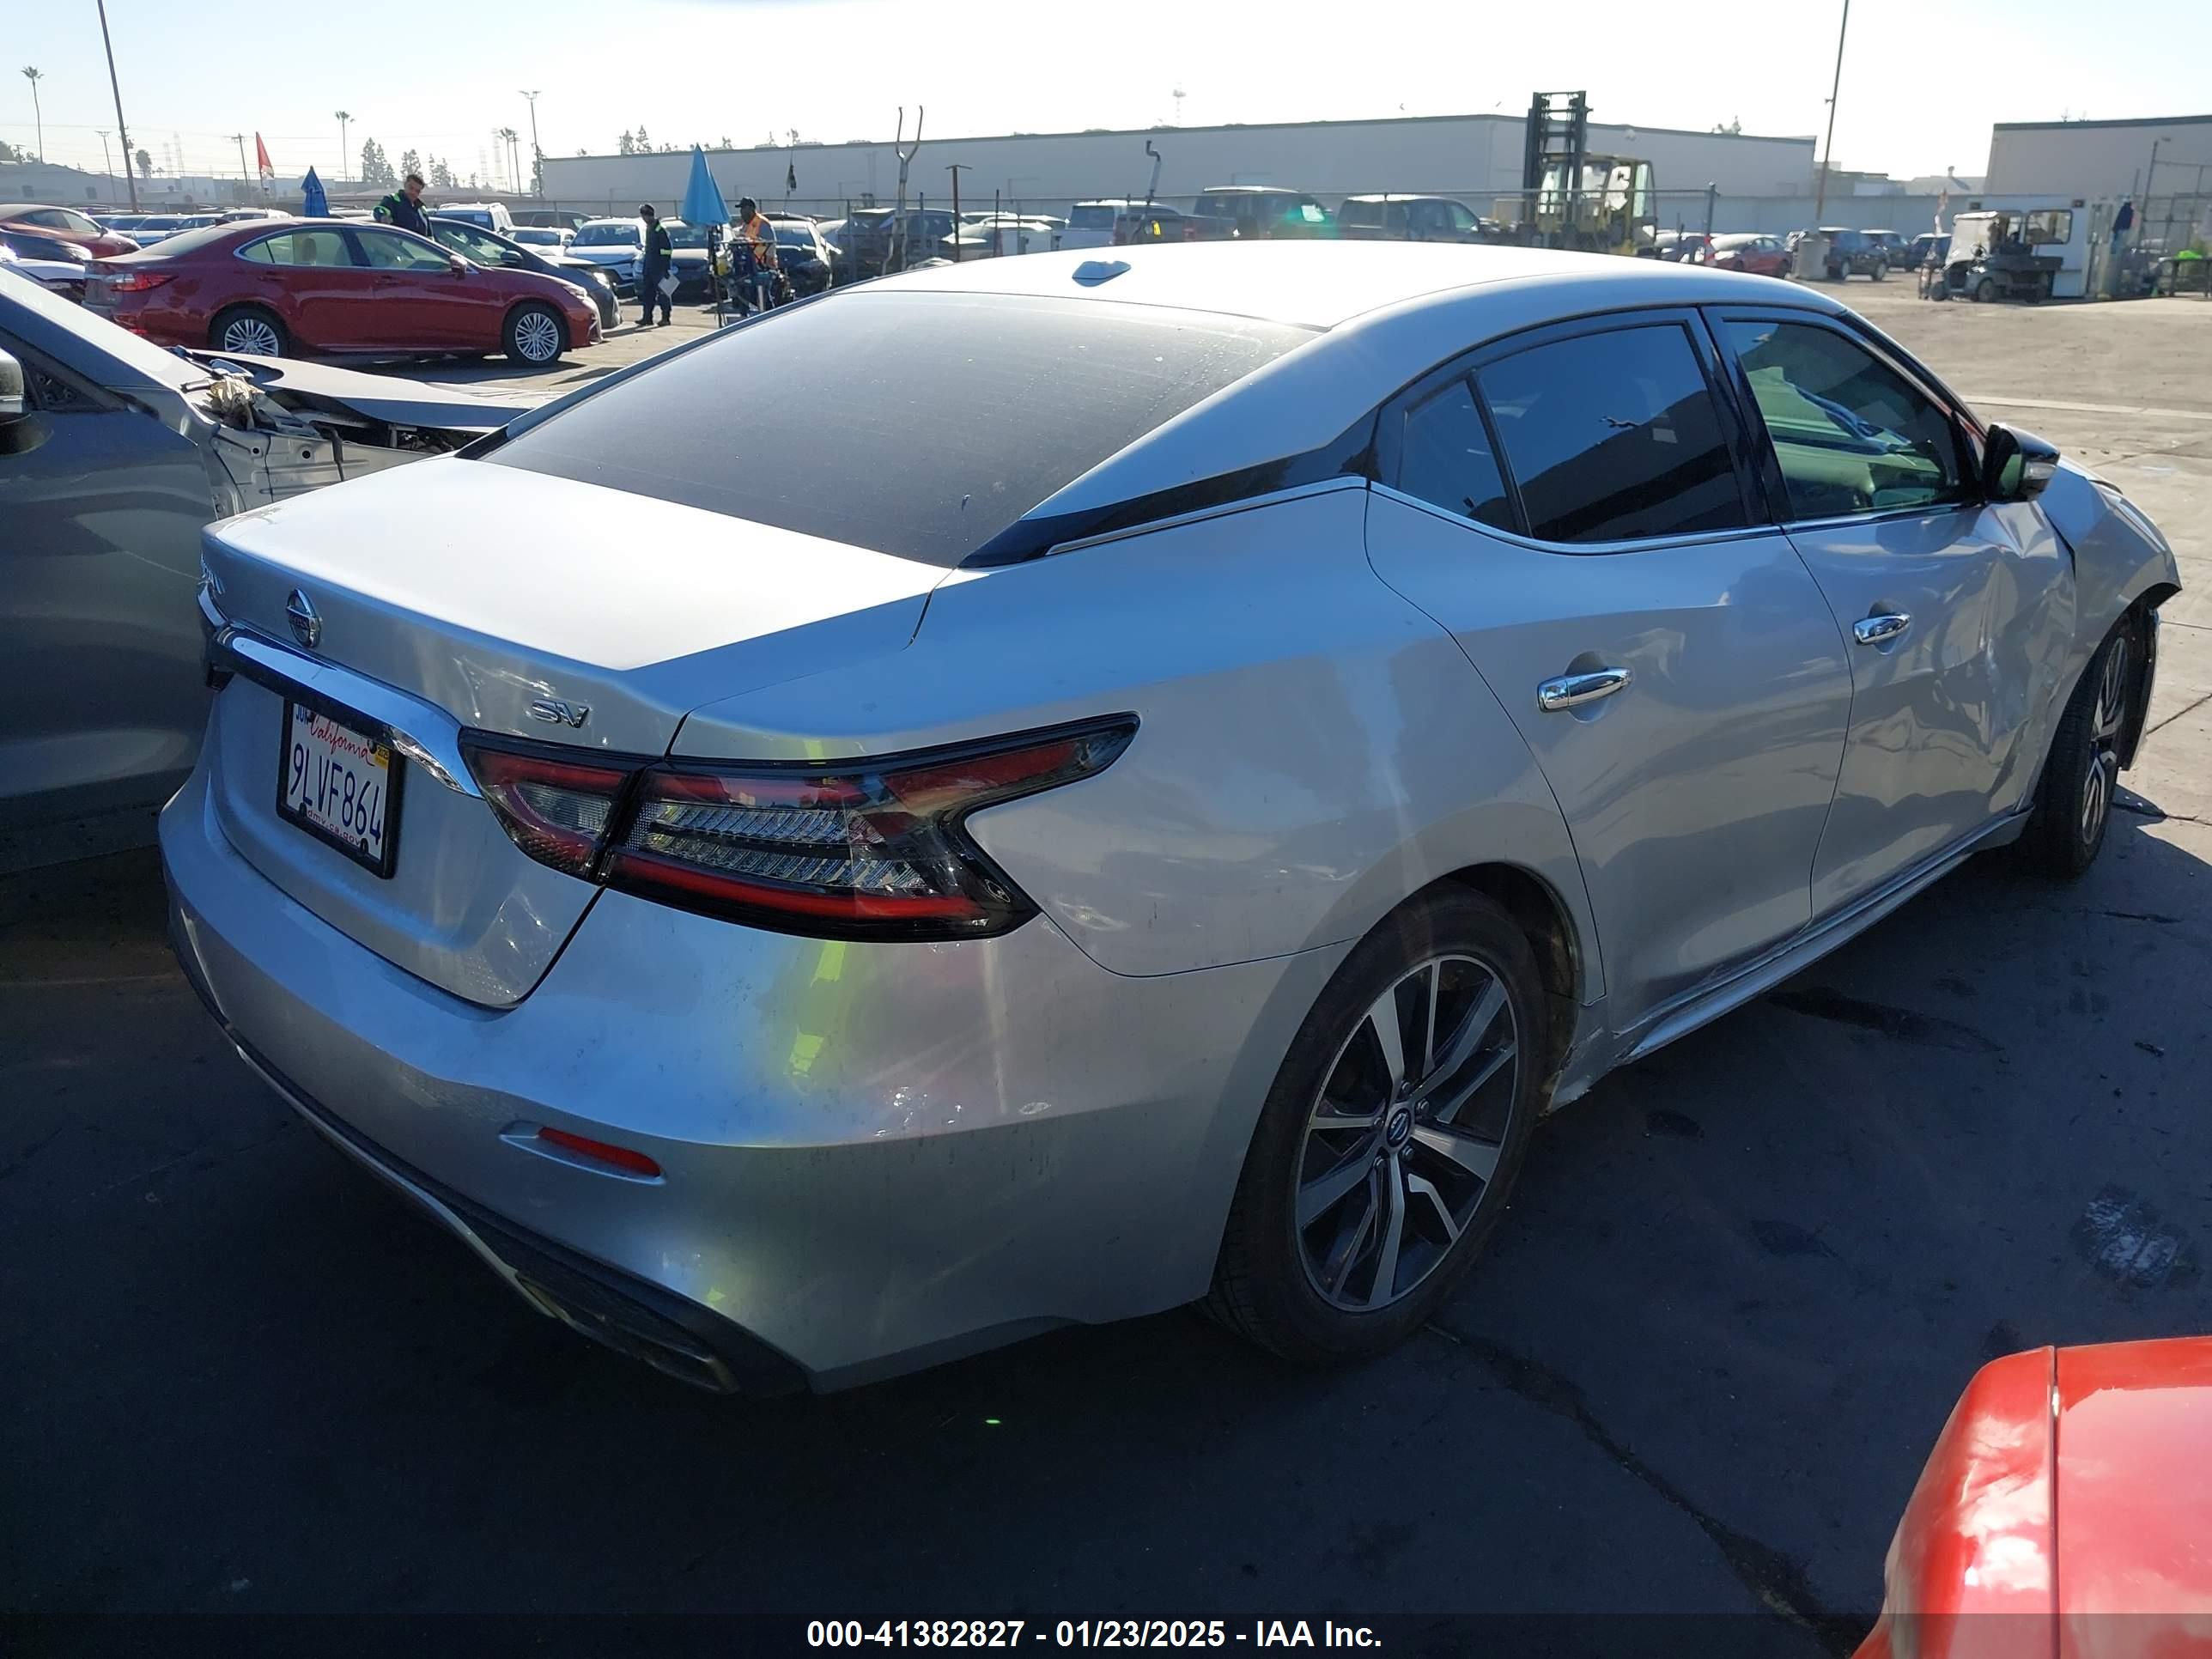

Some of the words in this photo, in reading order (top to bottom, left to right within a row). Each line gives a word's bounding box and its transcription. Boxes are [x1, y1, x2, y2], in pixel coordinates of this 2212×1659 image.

[532, 698, 592, 729] SV
[310, 714, 375, 766] California
[290, 743, 381, 846] 9LVF864
[307, 809, 361, 846] dmv.ca.gov
